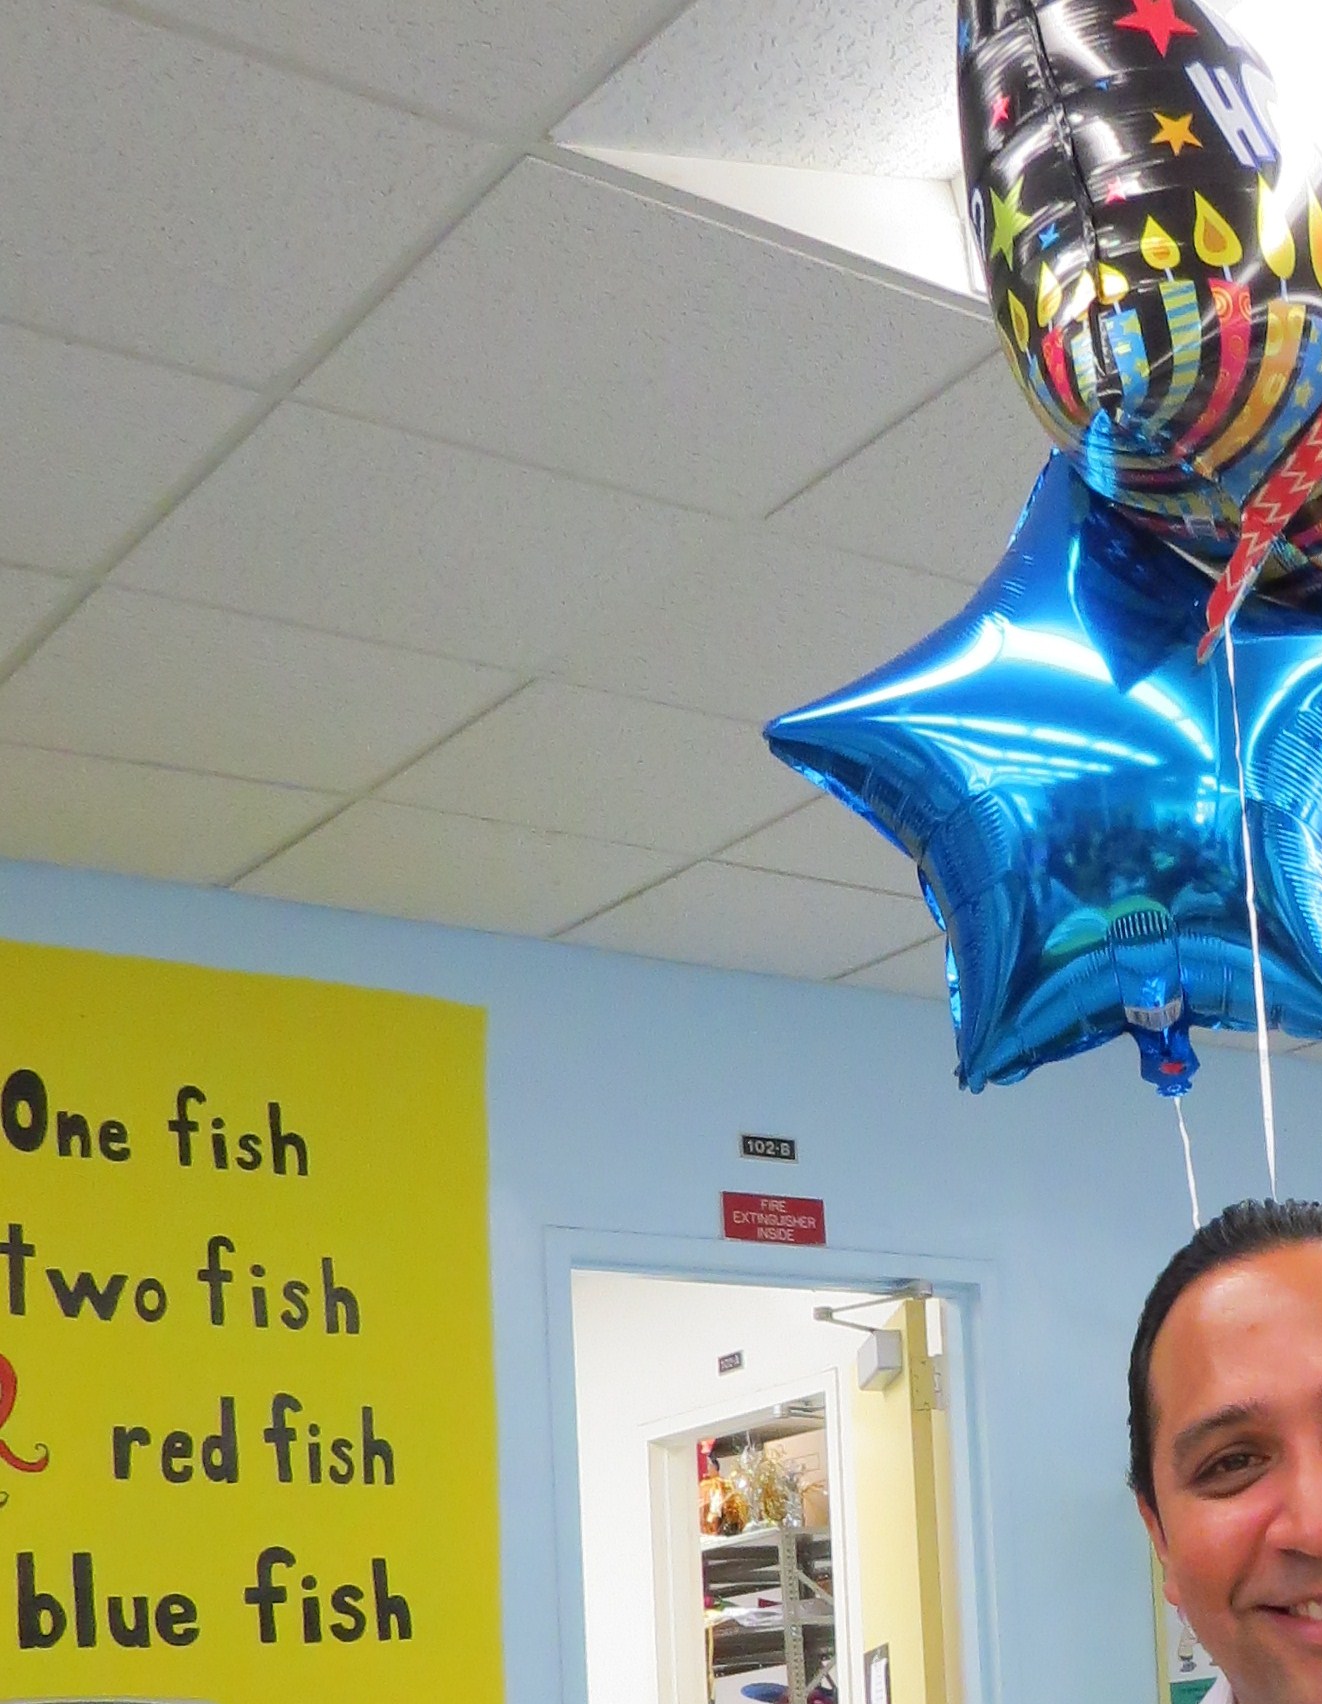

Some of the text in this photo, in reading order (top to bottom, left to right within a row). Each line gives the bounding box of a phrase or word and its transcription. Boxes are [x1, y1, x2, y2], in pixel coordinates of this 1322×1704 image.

[0, 1069, 309, 1176] One fish
[732, 1210, 817, 1229] EXTINGUISHER
[757, 1226, 795, 1242] INSIDE
[760, 1199, 787, 1213] FIRE
[0, 1223, 360, 1334] two fish
[112, 1392, 395, 1485] red fish
[16, 1546, 412, 1649] blue fish
